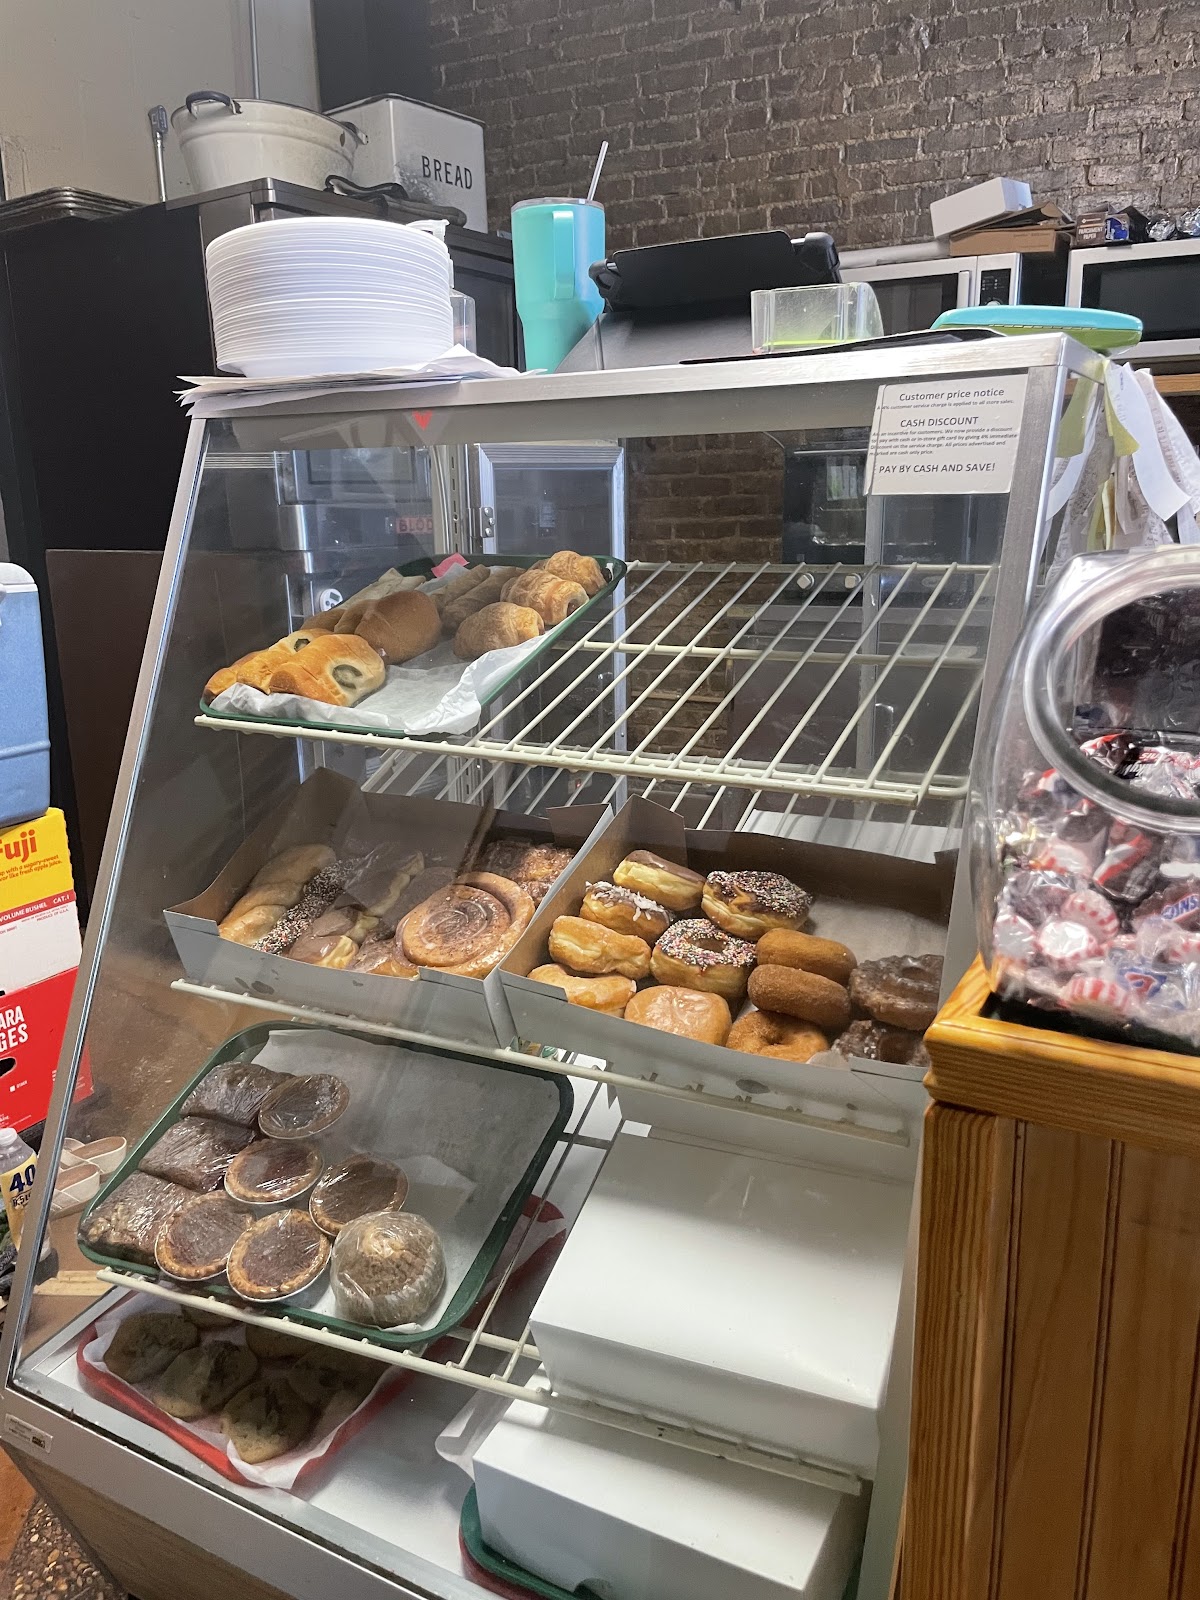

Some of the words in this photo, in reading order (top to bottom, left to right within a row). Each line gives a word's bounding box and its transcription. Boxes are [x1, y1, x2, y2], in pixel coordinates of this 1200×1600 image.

[421, 155, 473, 190] BREAD
[899, 391, 945, 402] Customer
[946, 390, 971, 401] price
[973, 388, 1005, 398] notice
[900, 419, 926, 428] CASH
[927, 416, 979, 427] DISCOUNT
[952, 440, 968, 448] prices
[879, 464, 898, 474] PAY
[898, 464, 912, 473] BY
[913, 463, 939, 473] CASH
[940, 462, 964, 473] AND
[965, 461, 996, 472] SAVE!
[0, 829, 37, 863] uji
[6, 866, 19, 874] with
[23, 854, 59, 869] sugary-sweet
[25, 901, 47, 914] BUSHEL
